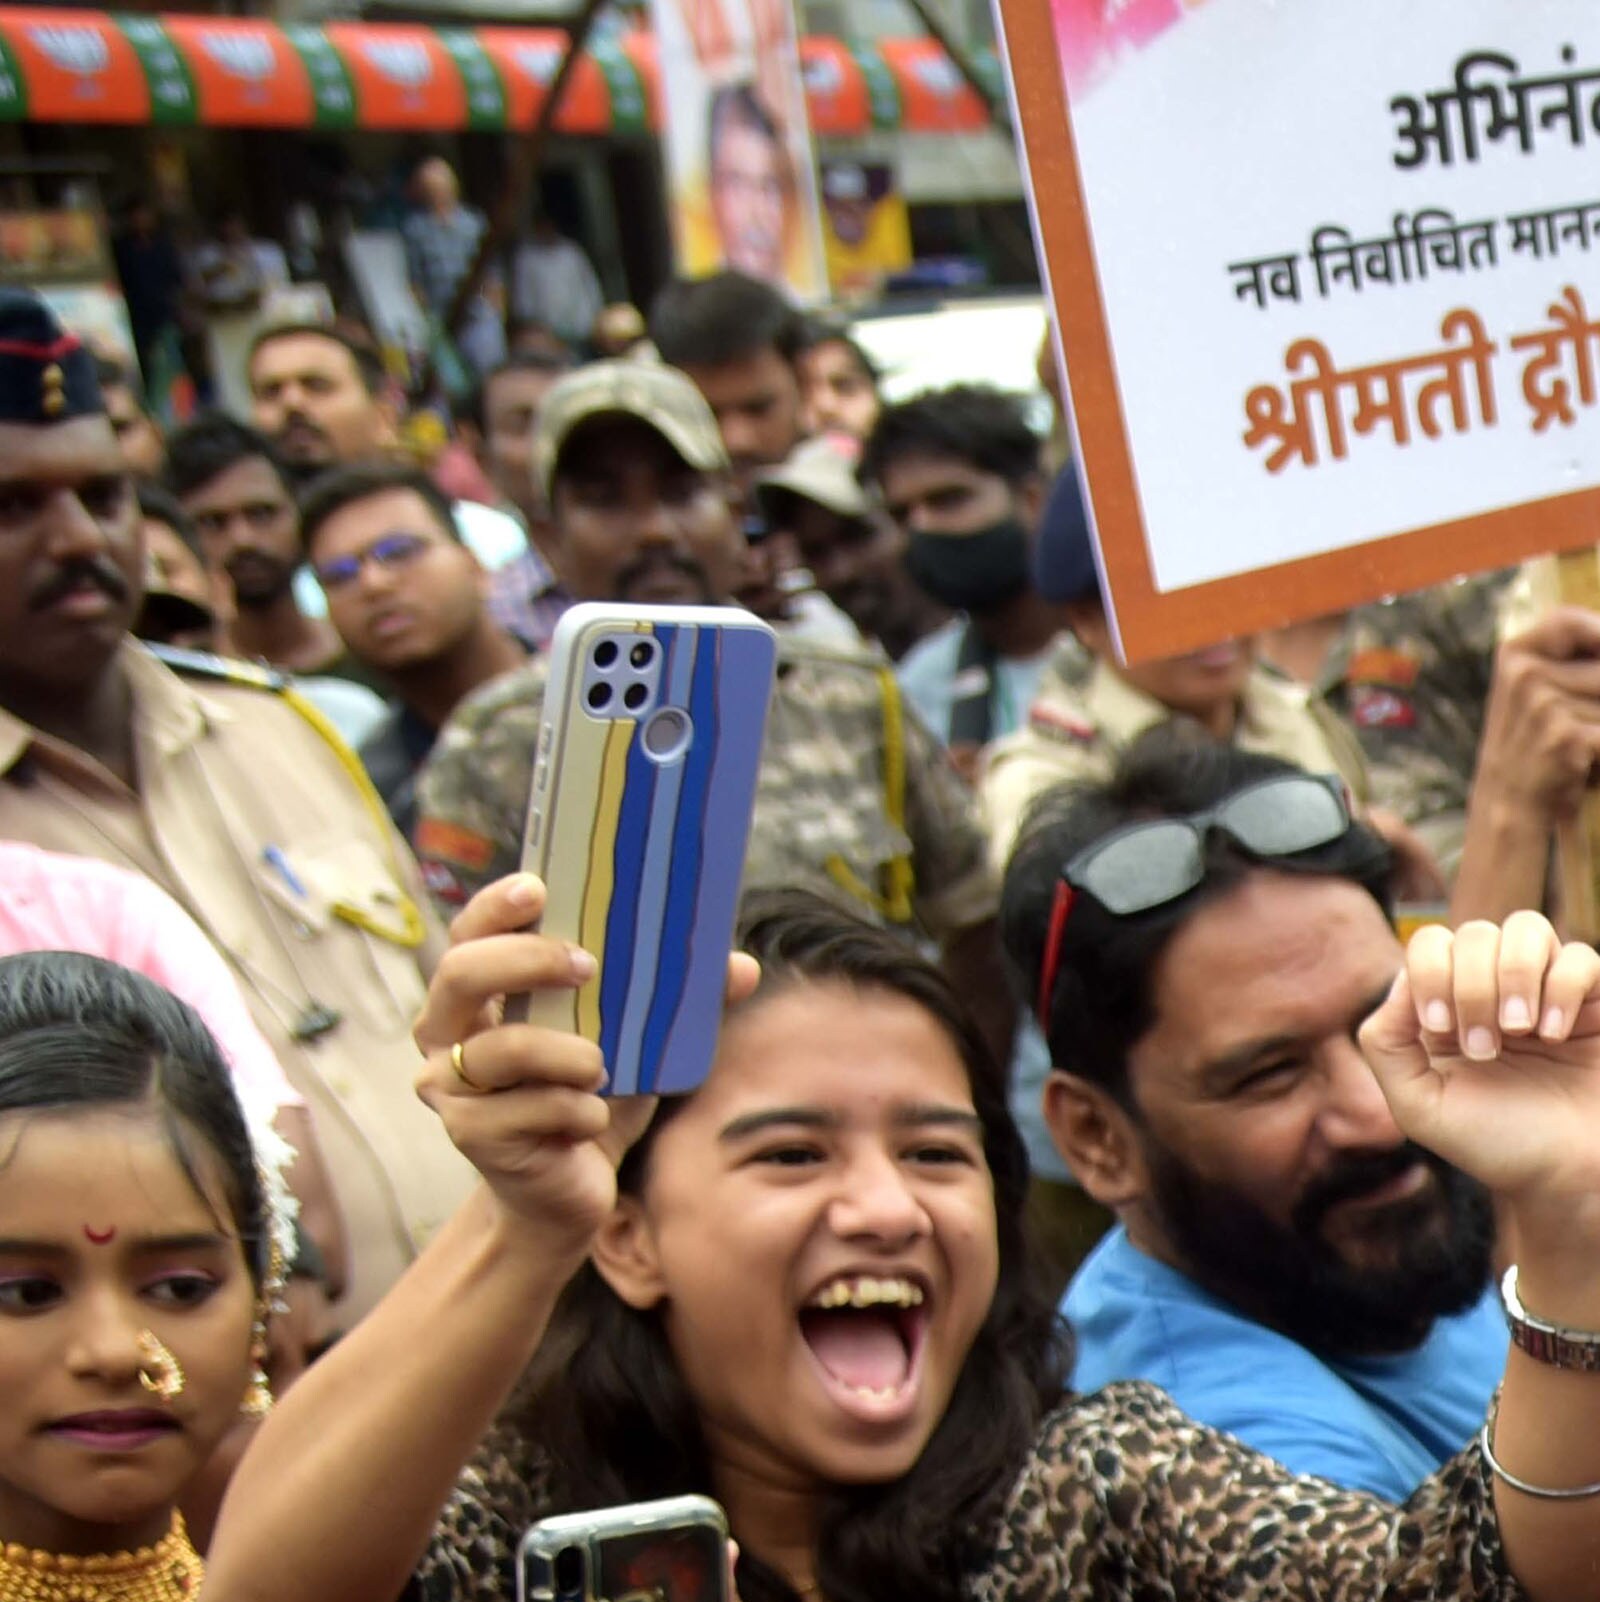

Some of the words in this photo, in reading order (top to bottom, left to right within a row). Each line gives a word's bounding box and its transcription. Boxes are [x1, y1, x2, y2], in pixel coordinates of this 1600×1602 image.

[1227, 253, 1302, 309] नव
[1308, 208, 1498, 298] निर्वाचित
[1242, 307, 1497, 473] श्रीमती
